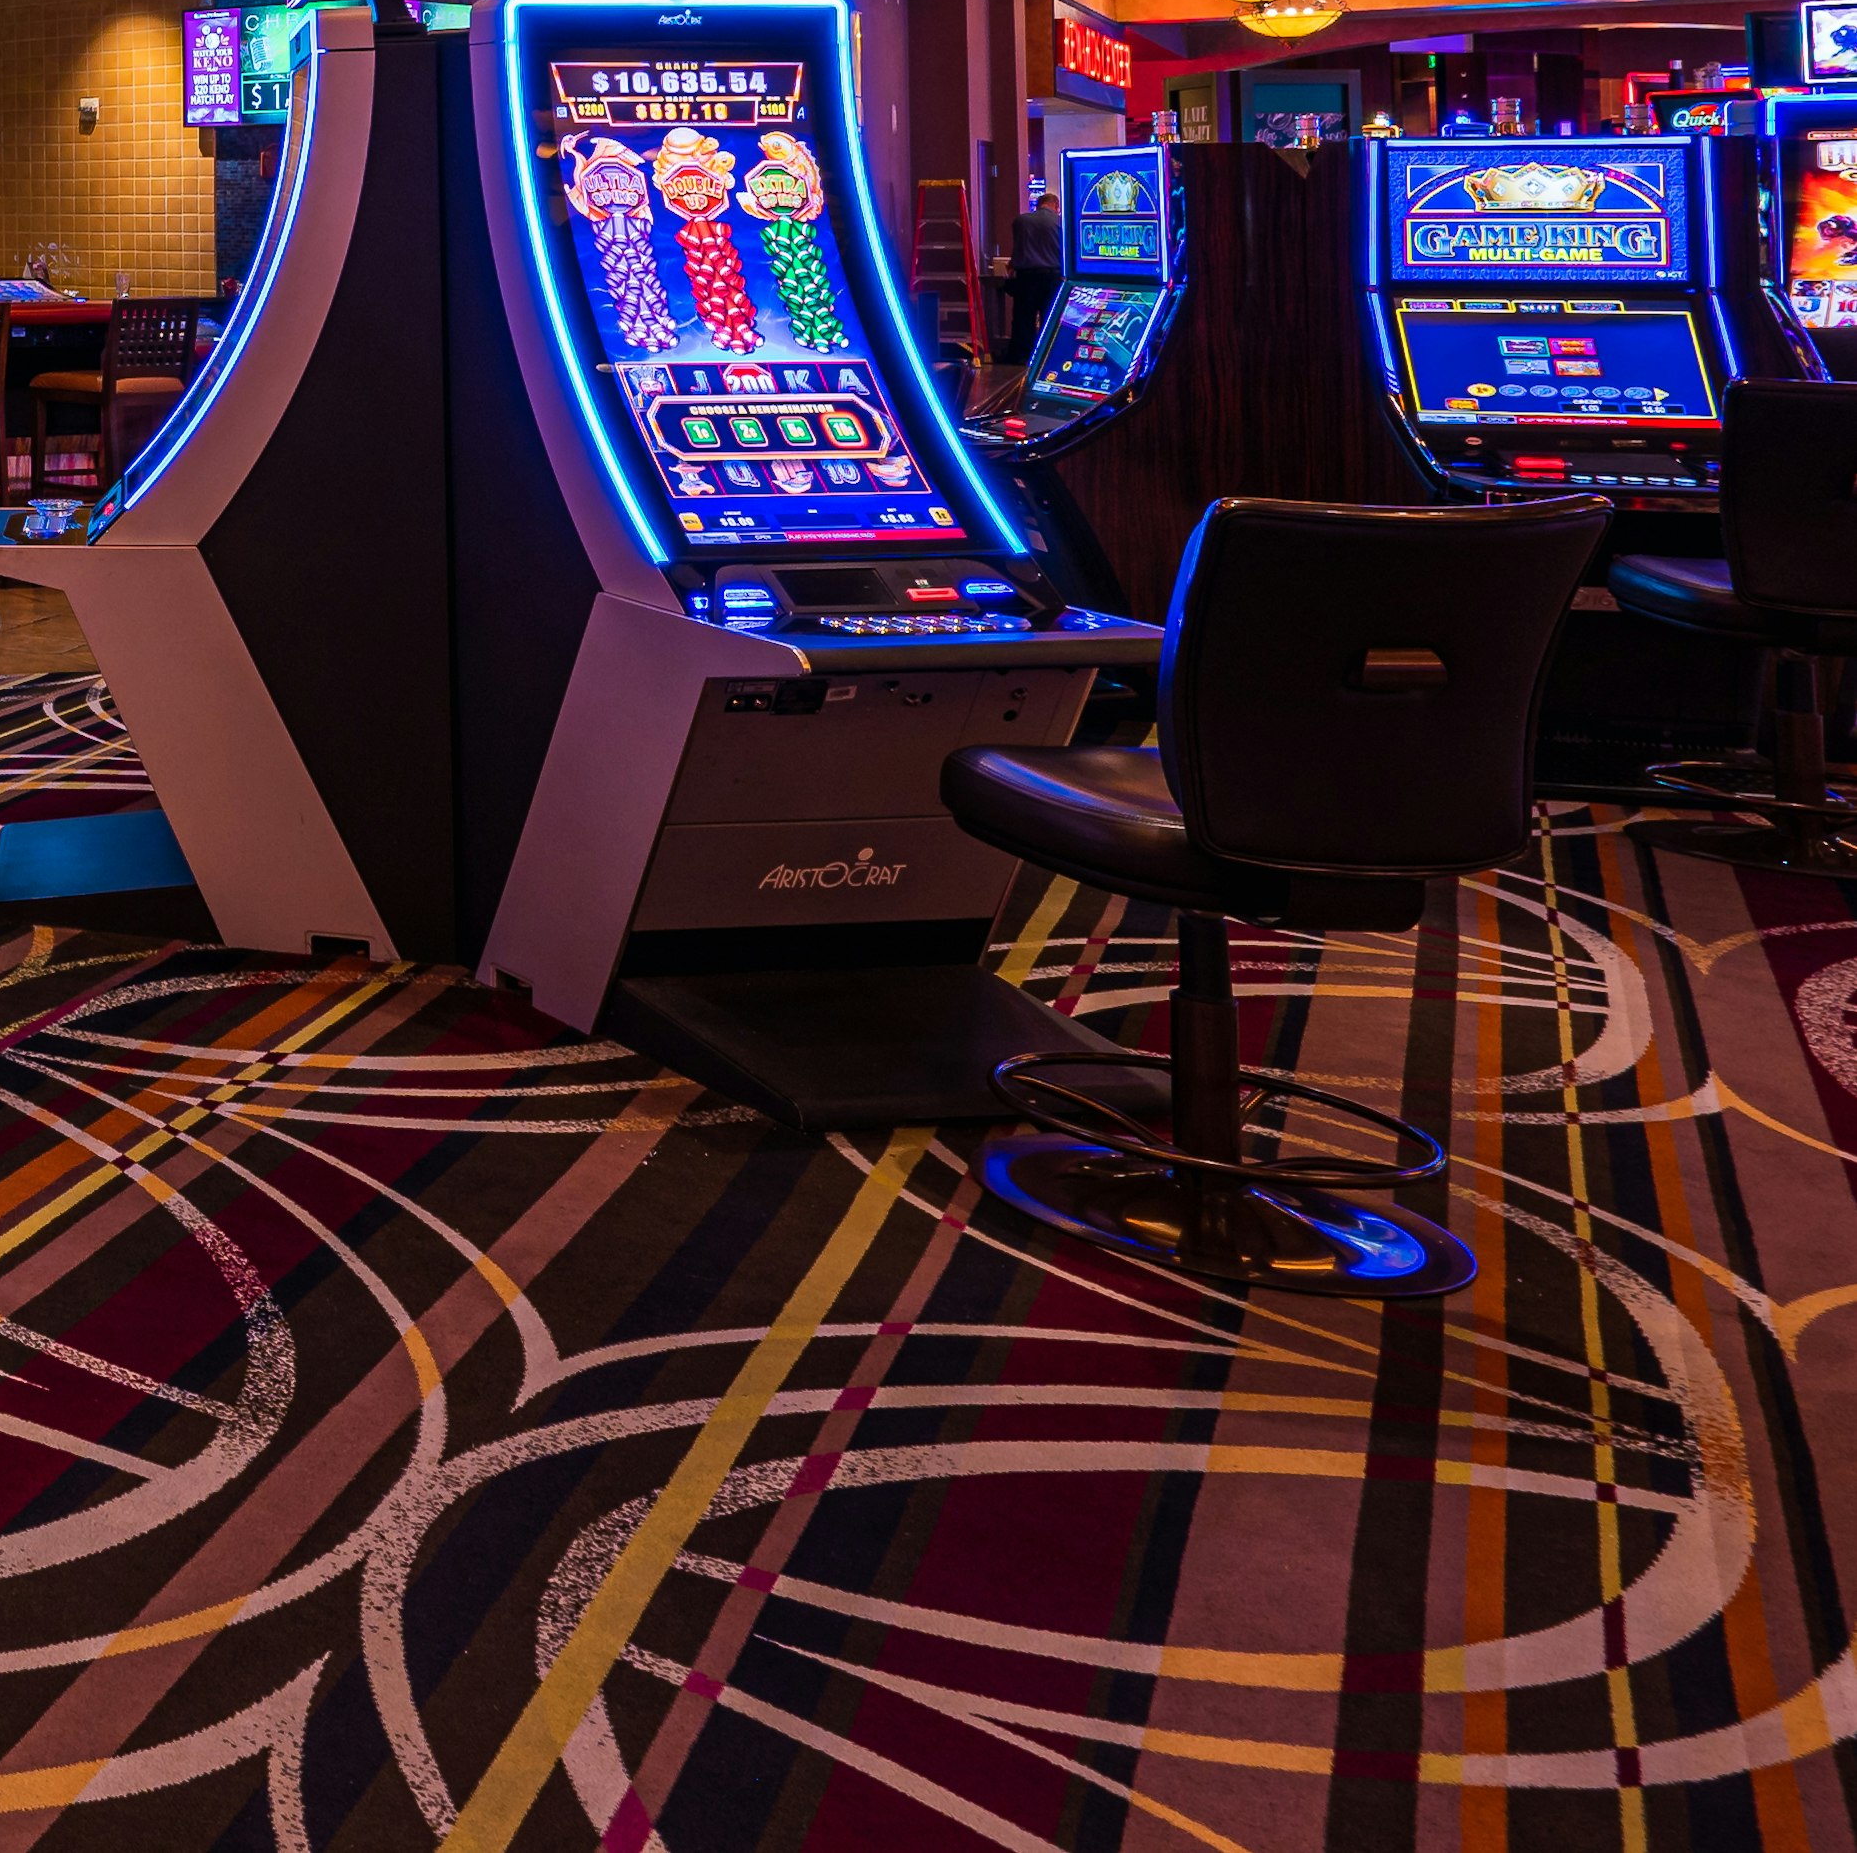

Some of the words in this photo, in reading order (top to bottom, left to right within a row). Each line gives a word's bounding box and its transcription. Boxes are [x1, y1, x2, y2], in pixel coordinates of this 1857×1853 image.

[193, 56, 233, 68] KENO
[193, 74, 209, 85] WIN
[209, 74, 220, 84] UP
[220, 73, 231, 83] TO
[592, 71, 767, 95] $10,635.54
[209, 84, 230, 94] KENO
[190, 94, 215, 105] MATCH
[215, 94, 234, 104] PLAY
[578, 104, 605, 116] $200
[760, 103, 786, 116] $100
[1184, 106, 1208, 124] LATE
[1672, 110, 1720, 128] Quick
[1183, 125, 1212, 141] NIGHT
[584, 174, 645, 195] ULTRA
[664, 175, 722, 199] DOUBLE
[749, 175, 806, 196] EXTRA
[592, 191, 637, 206] SPINS
[686, 196, 708, 211] UP
[759, 194, 801, 208] SPINS
[1083, 225, 1120, 253] GAME
[1122, 225, 1157, 255] KING
[1414, 224, 1540, 258] GAME
[1546, 224, 1657, 259] KING
[1099, 245, 1140, 257] MULTI-GAME
[1469, 248, 1603, 261] MULTI-GAME
[690, 370, 709, 394] J
[782, 369, 817, 394] K
[838, 368, 870, 395] A
[689, 405, 736, 415] CHOOSE
[738, 405, 747, 415] A
[749, 404, 835, 415] DENOMINATION
[821, 459, 860, 484] 10
[758, 859, 907, 890] ARISTOCRAT
